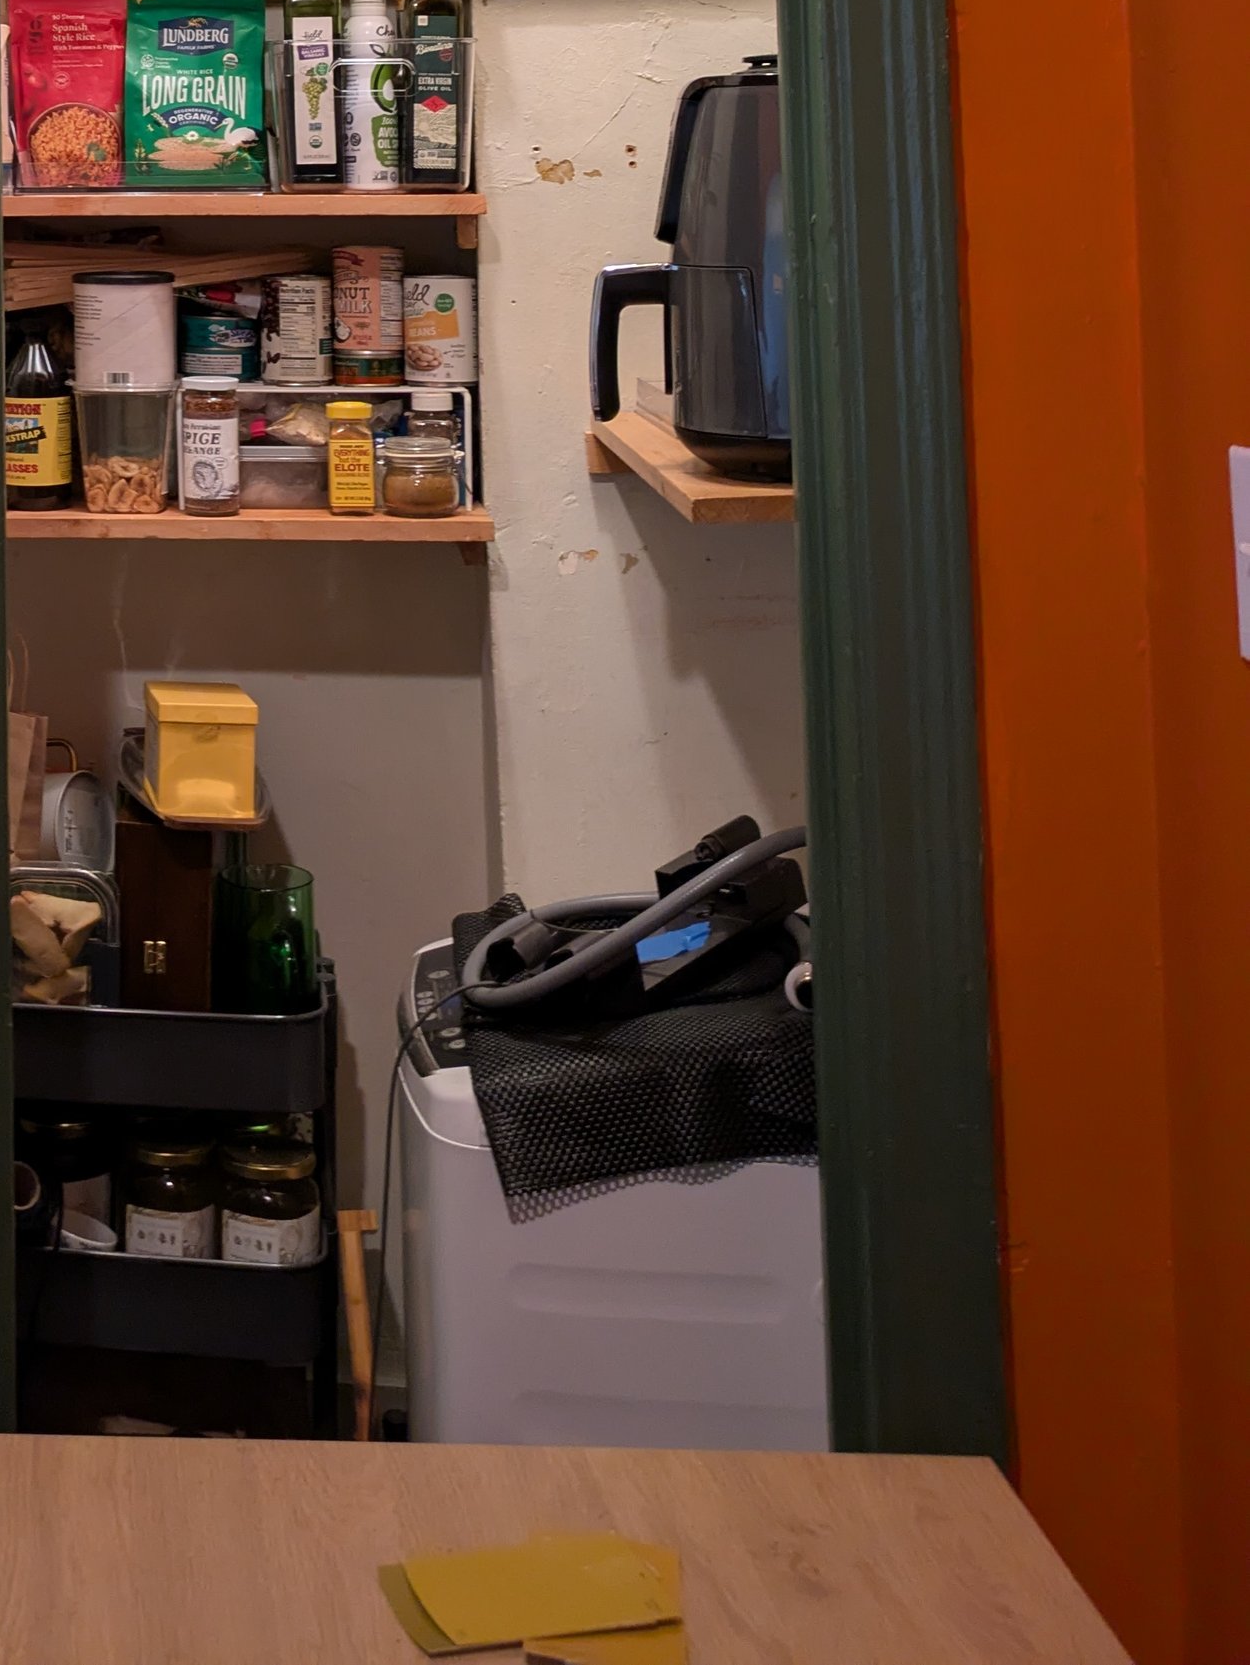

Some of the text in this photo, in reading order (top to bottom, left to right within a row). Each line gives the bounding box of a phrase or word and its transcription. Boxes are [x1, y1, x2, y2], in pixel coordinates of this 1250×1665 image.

[52, 22, 88, 33] Spanish
[52, 32, 96, 44] Style Rice
[162, 27, 229, 47] LUNDBERG
[417, 76, 452, 85] EXTRA VIRGIN
[141, 74, 247, 120] LONG GRAIN
[168, 112, 219, 125] ORGANIC
[377, 138, 391, 149] OIL
[338, 300, 373, 314] MILK
[334, 463, 370, 472] ELOTE
